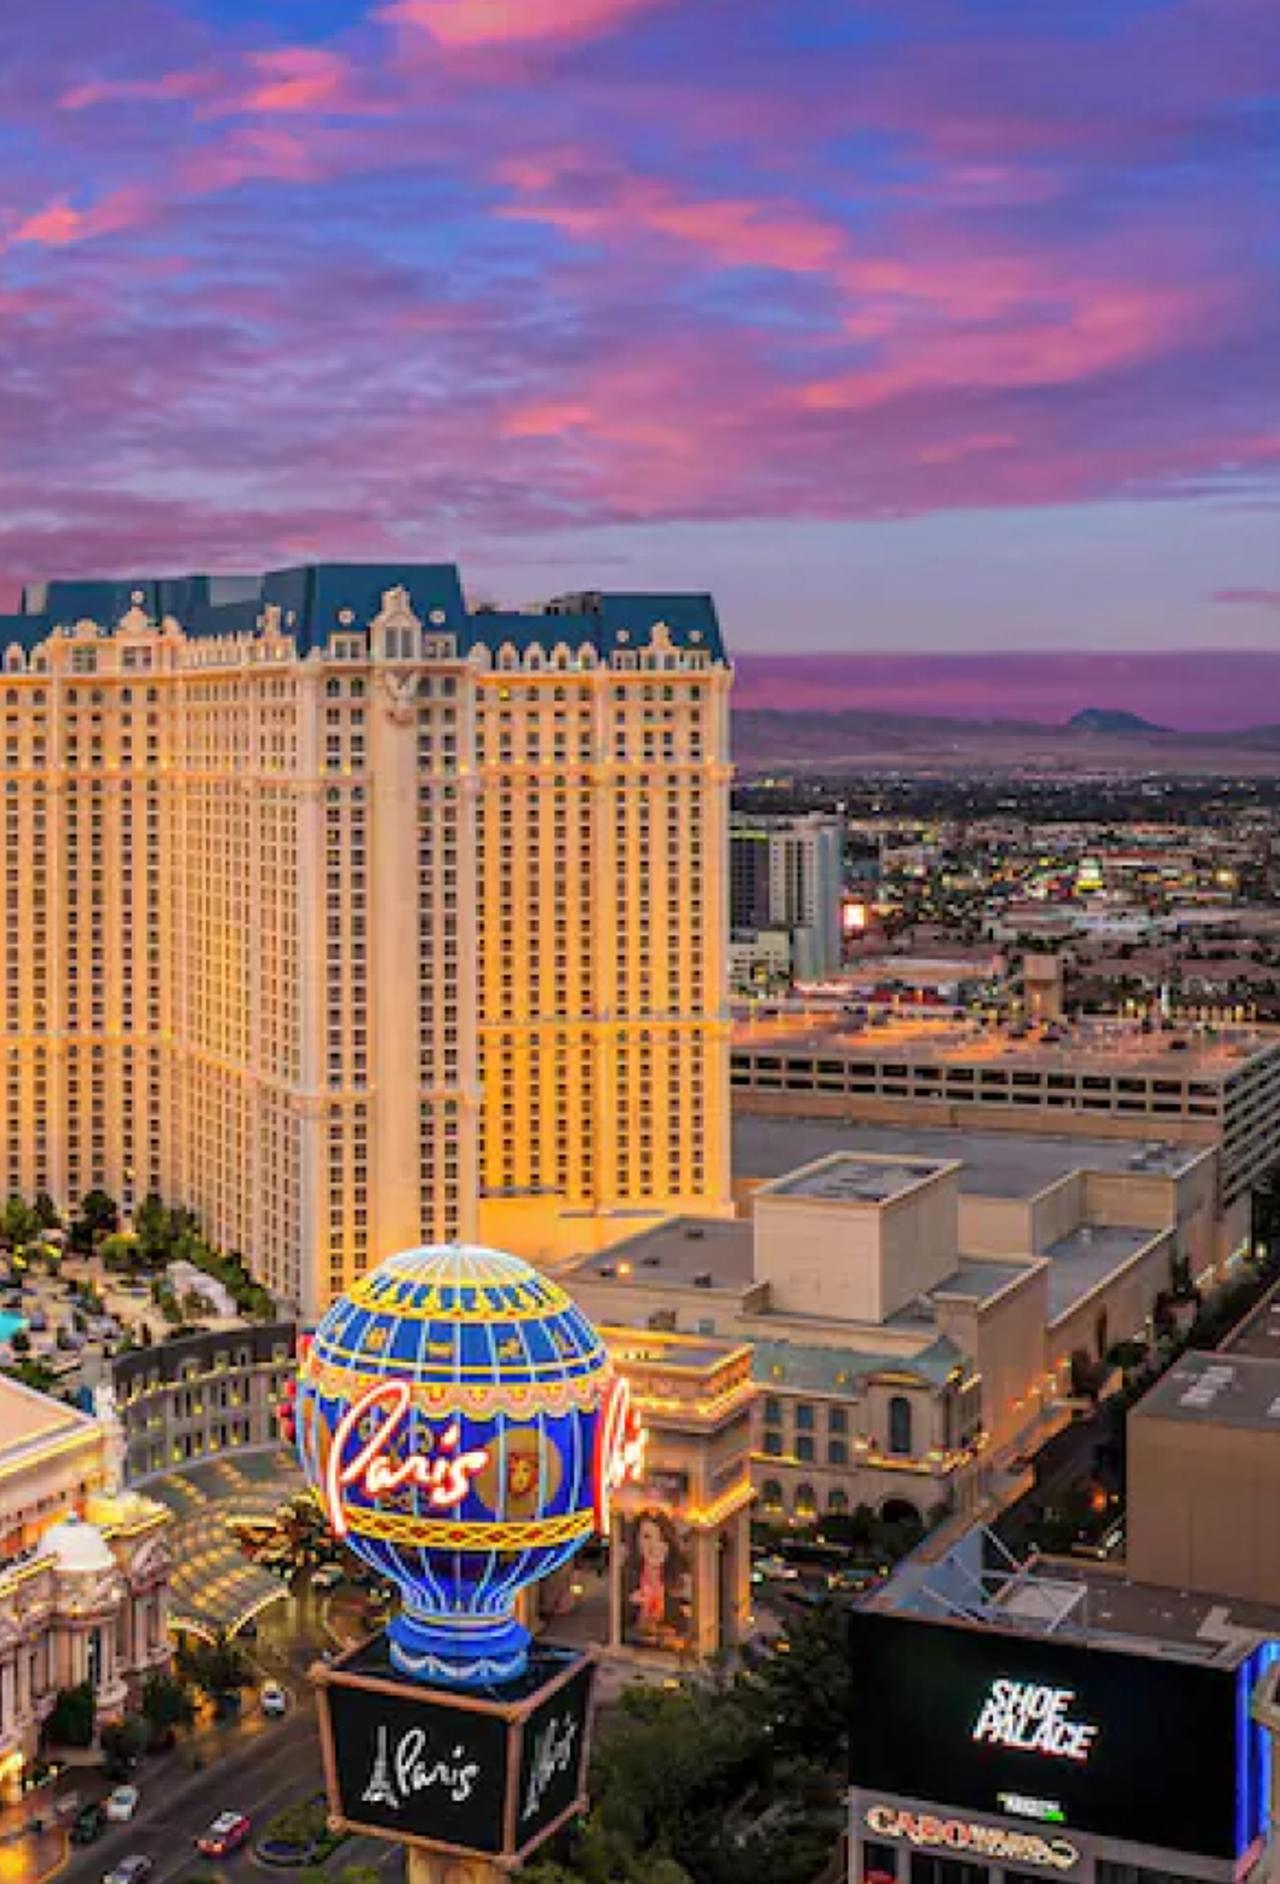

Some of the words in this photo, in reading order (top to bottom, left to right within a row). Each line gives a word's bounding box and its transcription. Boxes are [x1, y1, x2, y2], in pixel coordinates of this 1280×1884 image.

[327, 1379, 488, 1535] Paris
[972, 1700, 1098, 1759] PALACE
[991, 1679, 1076, 1720] SHOE
[395, 1729, 480, 1801] Paris
